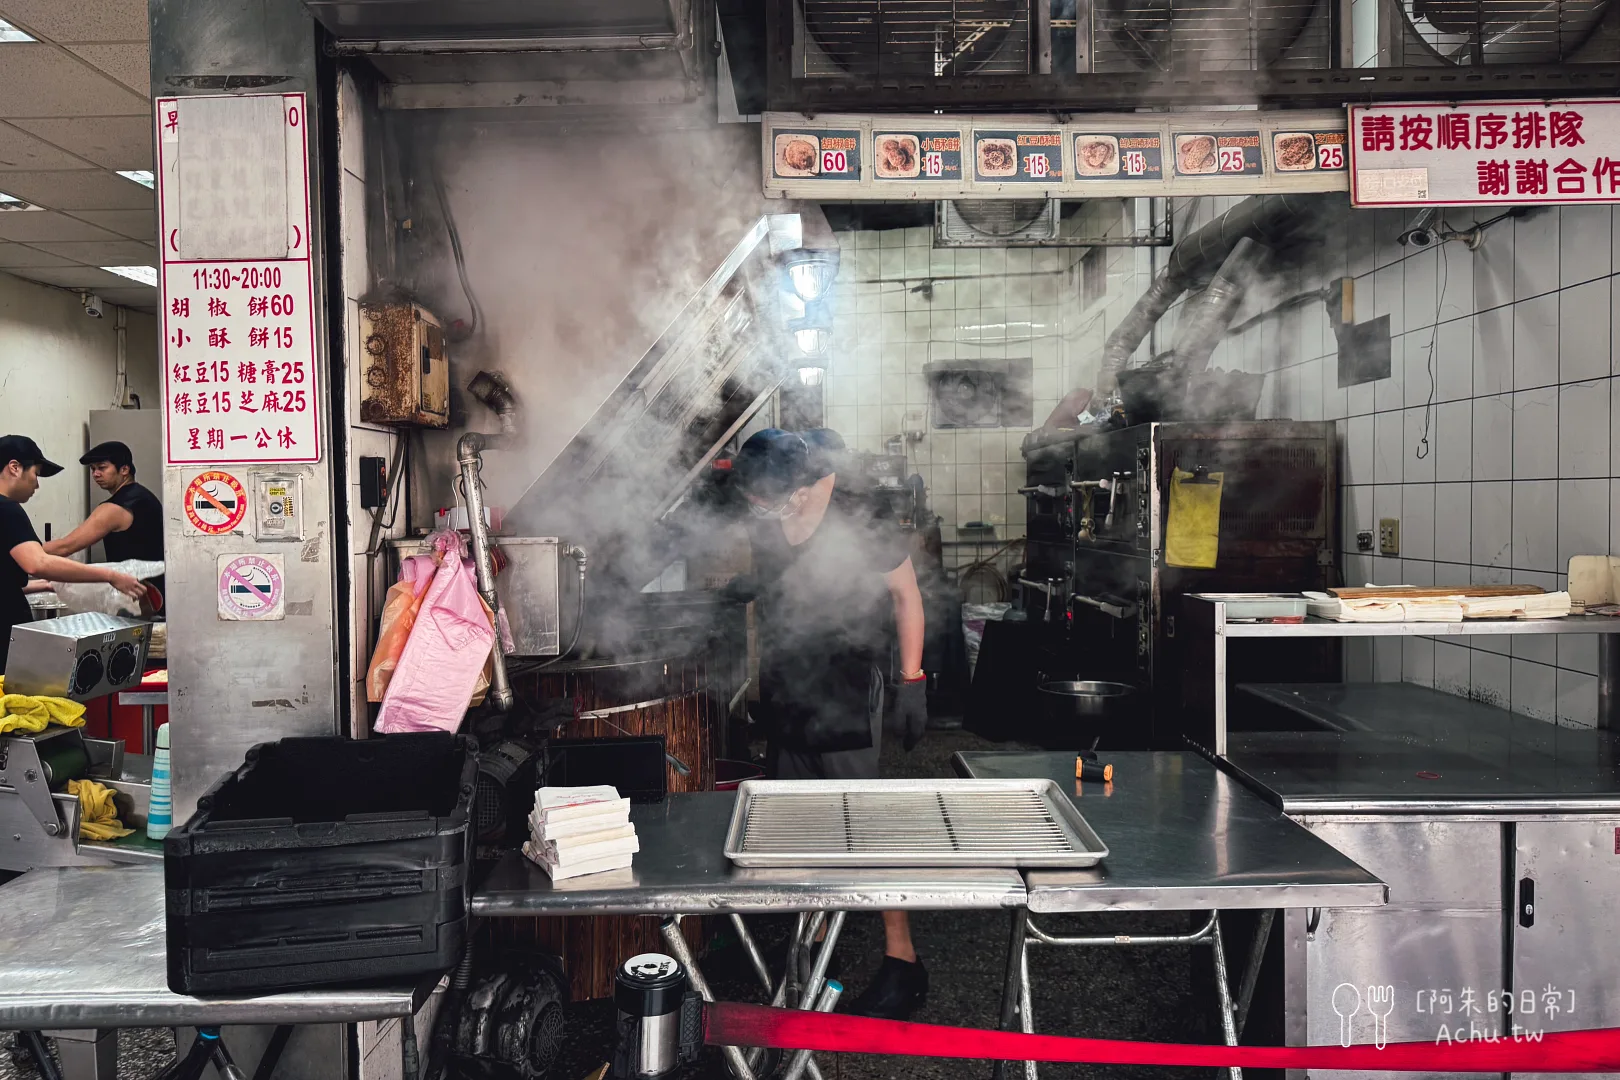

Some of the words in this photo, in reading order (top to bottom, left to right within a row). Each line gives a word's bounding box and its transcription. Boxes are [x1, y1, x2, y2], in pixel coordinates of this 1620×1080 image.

[1361, 111, 1585, 151] 請按順序排隊
[820, 137, 856, 150] 胡椒餅
[920, 137, 960, 151] 小酥餅
[823, 152, 846, 171] 60
[928, 154, 940, 174] 15
[1031, 155, 1044, 174] 15
[1129, 153, 1141, 172] 15
[1220, 151, 1243, 171] 25
[1320, 148, 1342, 167] 25
[1476, 157, 1620, 196] 謝謝合作
[193, 267, 281, 290] 11:30~20:00
[187, 426, 297, 450] 星期一公休
